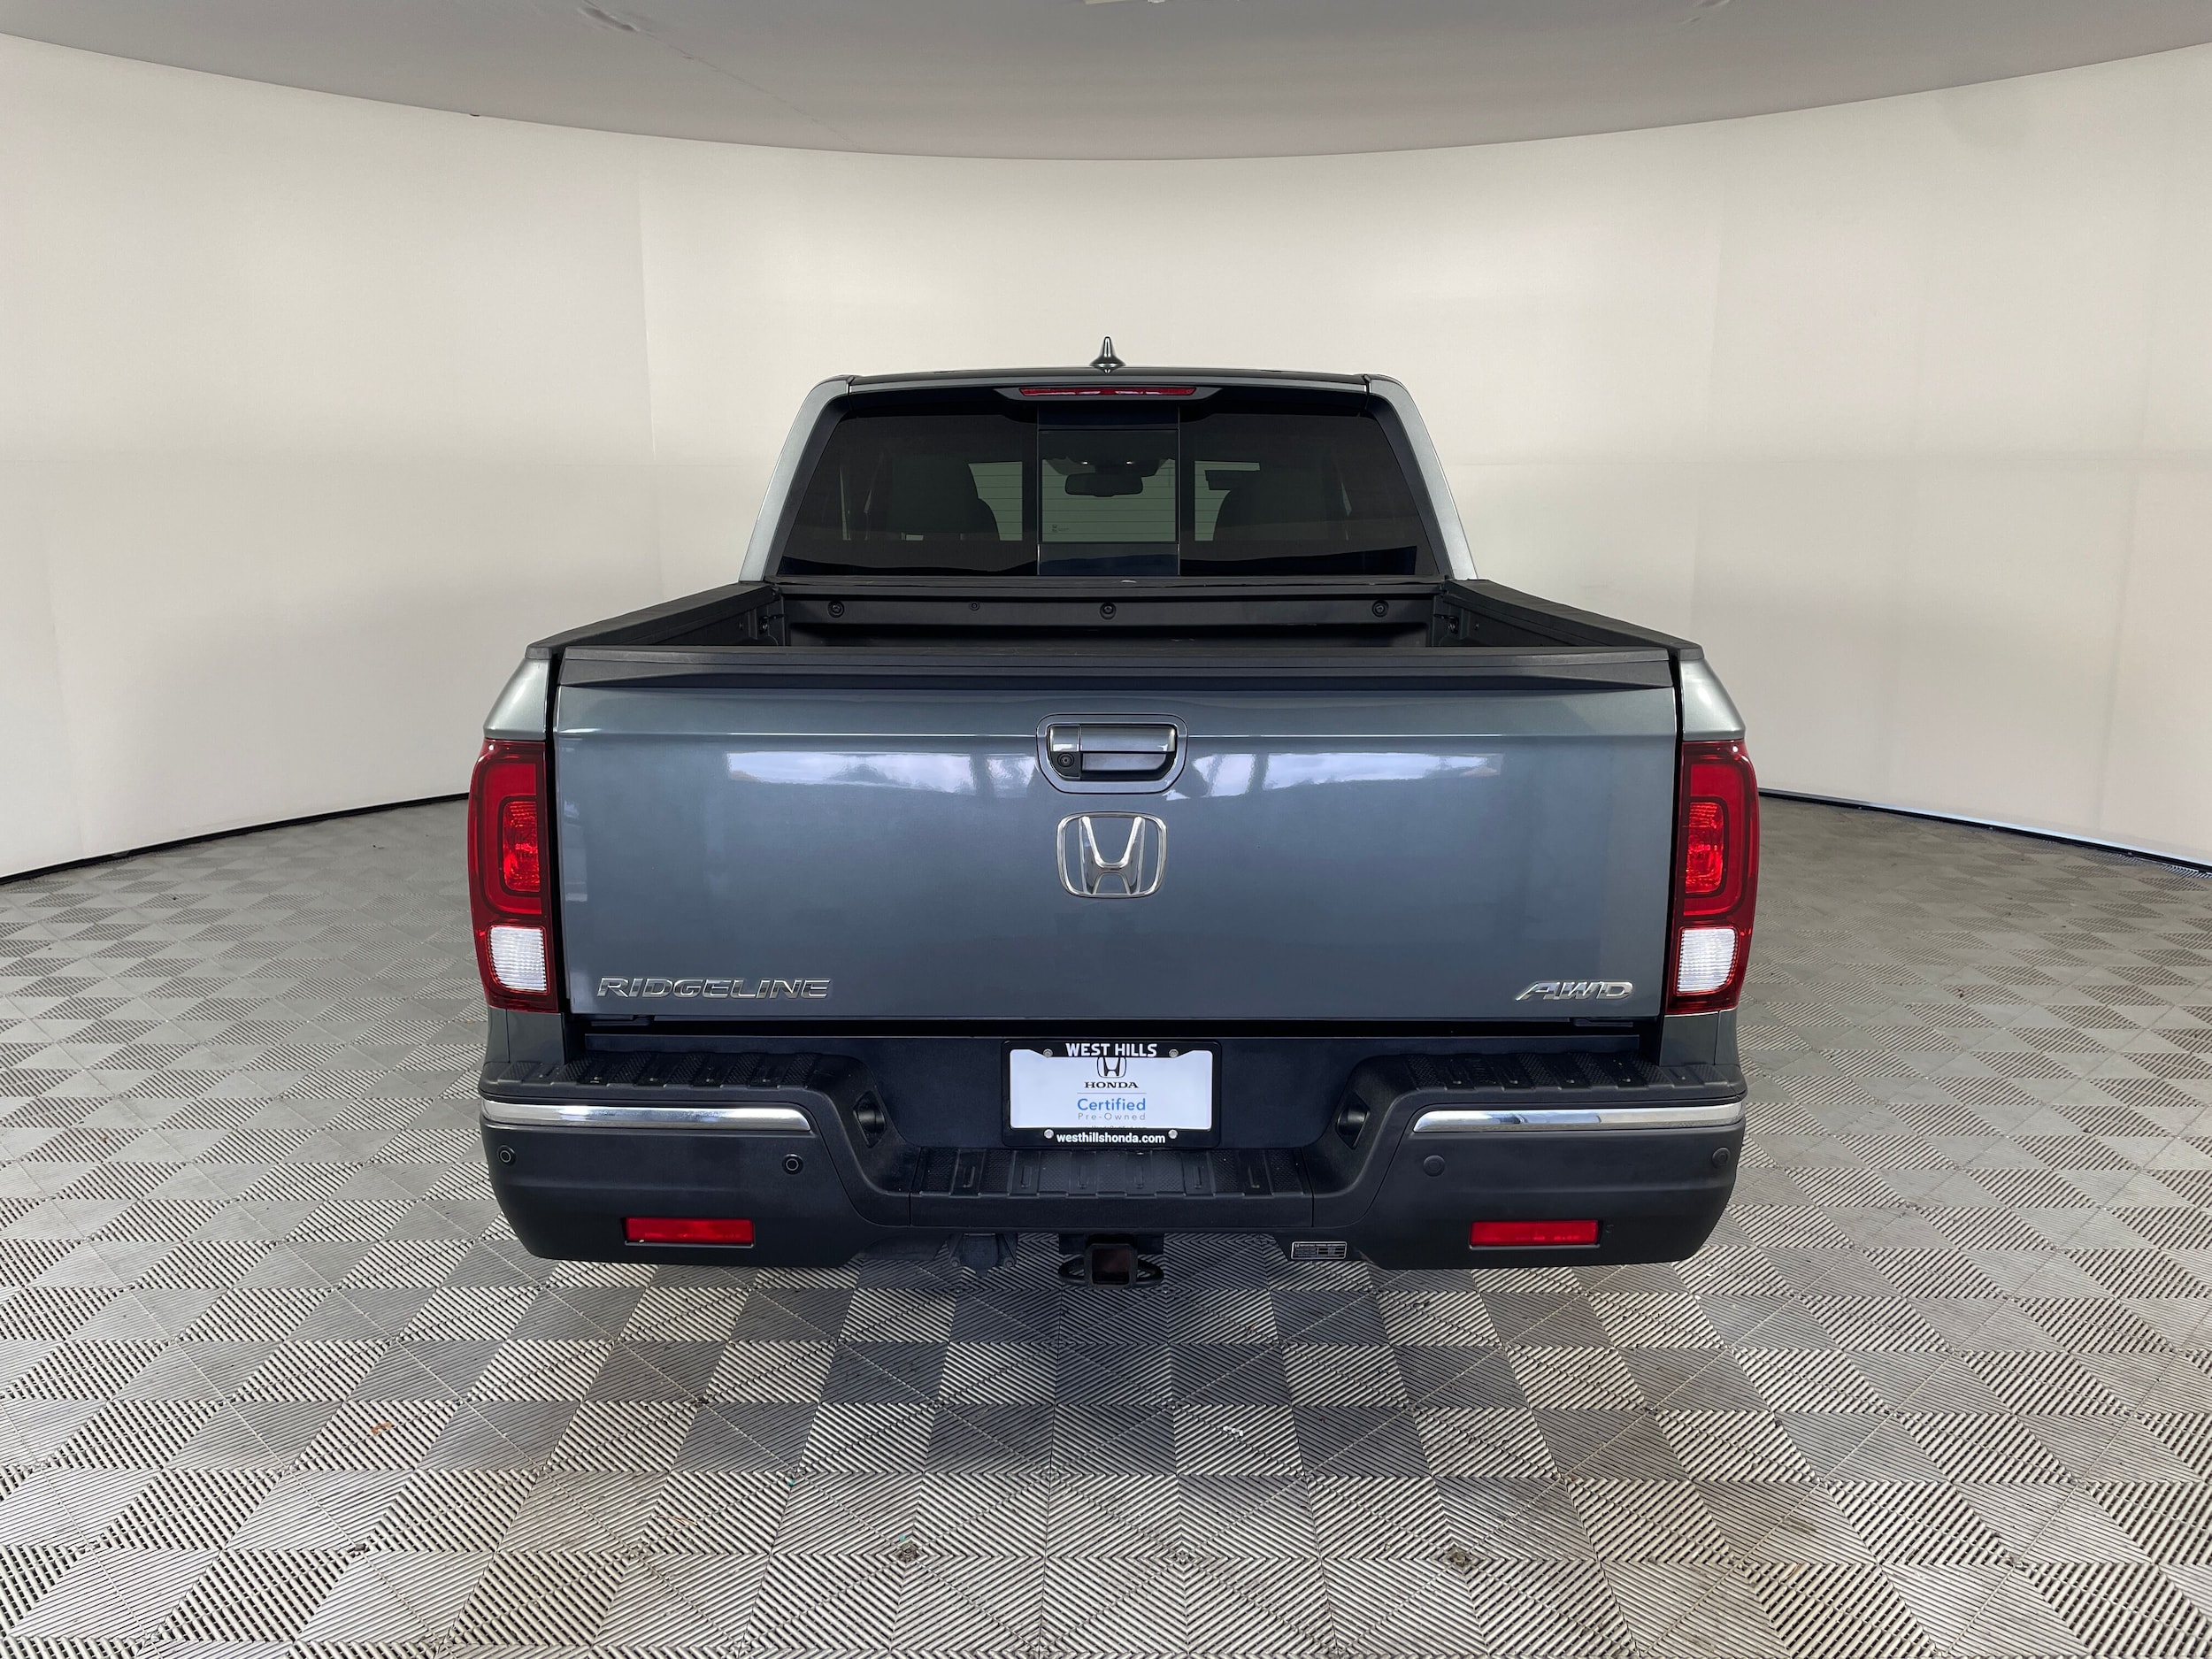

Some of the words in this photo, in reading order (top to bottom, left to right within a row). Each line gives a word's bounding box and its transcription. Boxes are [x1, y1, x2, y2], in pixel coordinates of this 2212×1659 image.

[596, 977, 831, 999] RIDGELINE
[1515, 980, 1633, 1001] AWD
[1065, 1043, 1110, 1056] WEST
[1115, 1043, 1157, 1057] HILLS
[1077, 1098, 1146, 1111] Certified
[1078, 1112, 1146, 1121] Pre-Owned
[1056, 1132, 1166, 1144] westhillshonda.com
